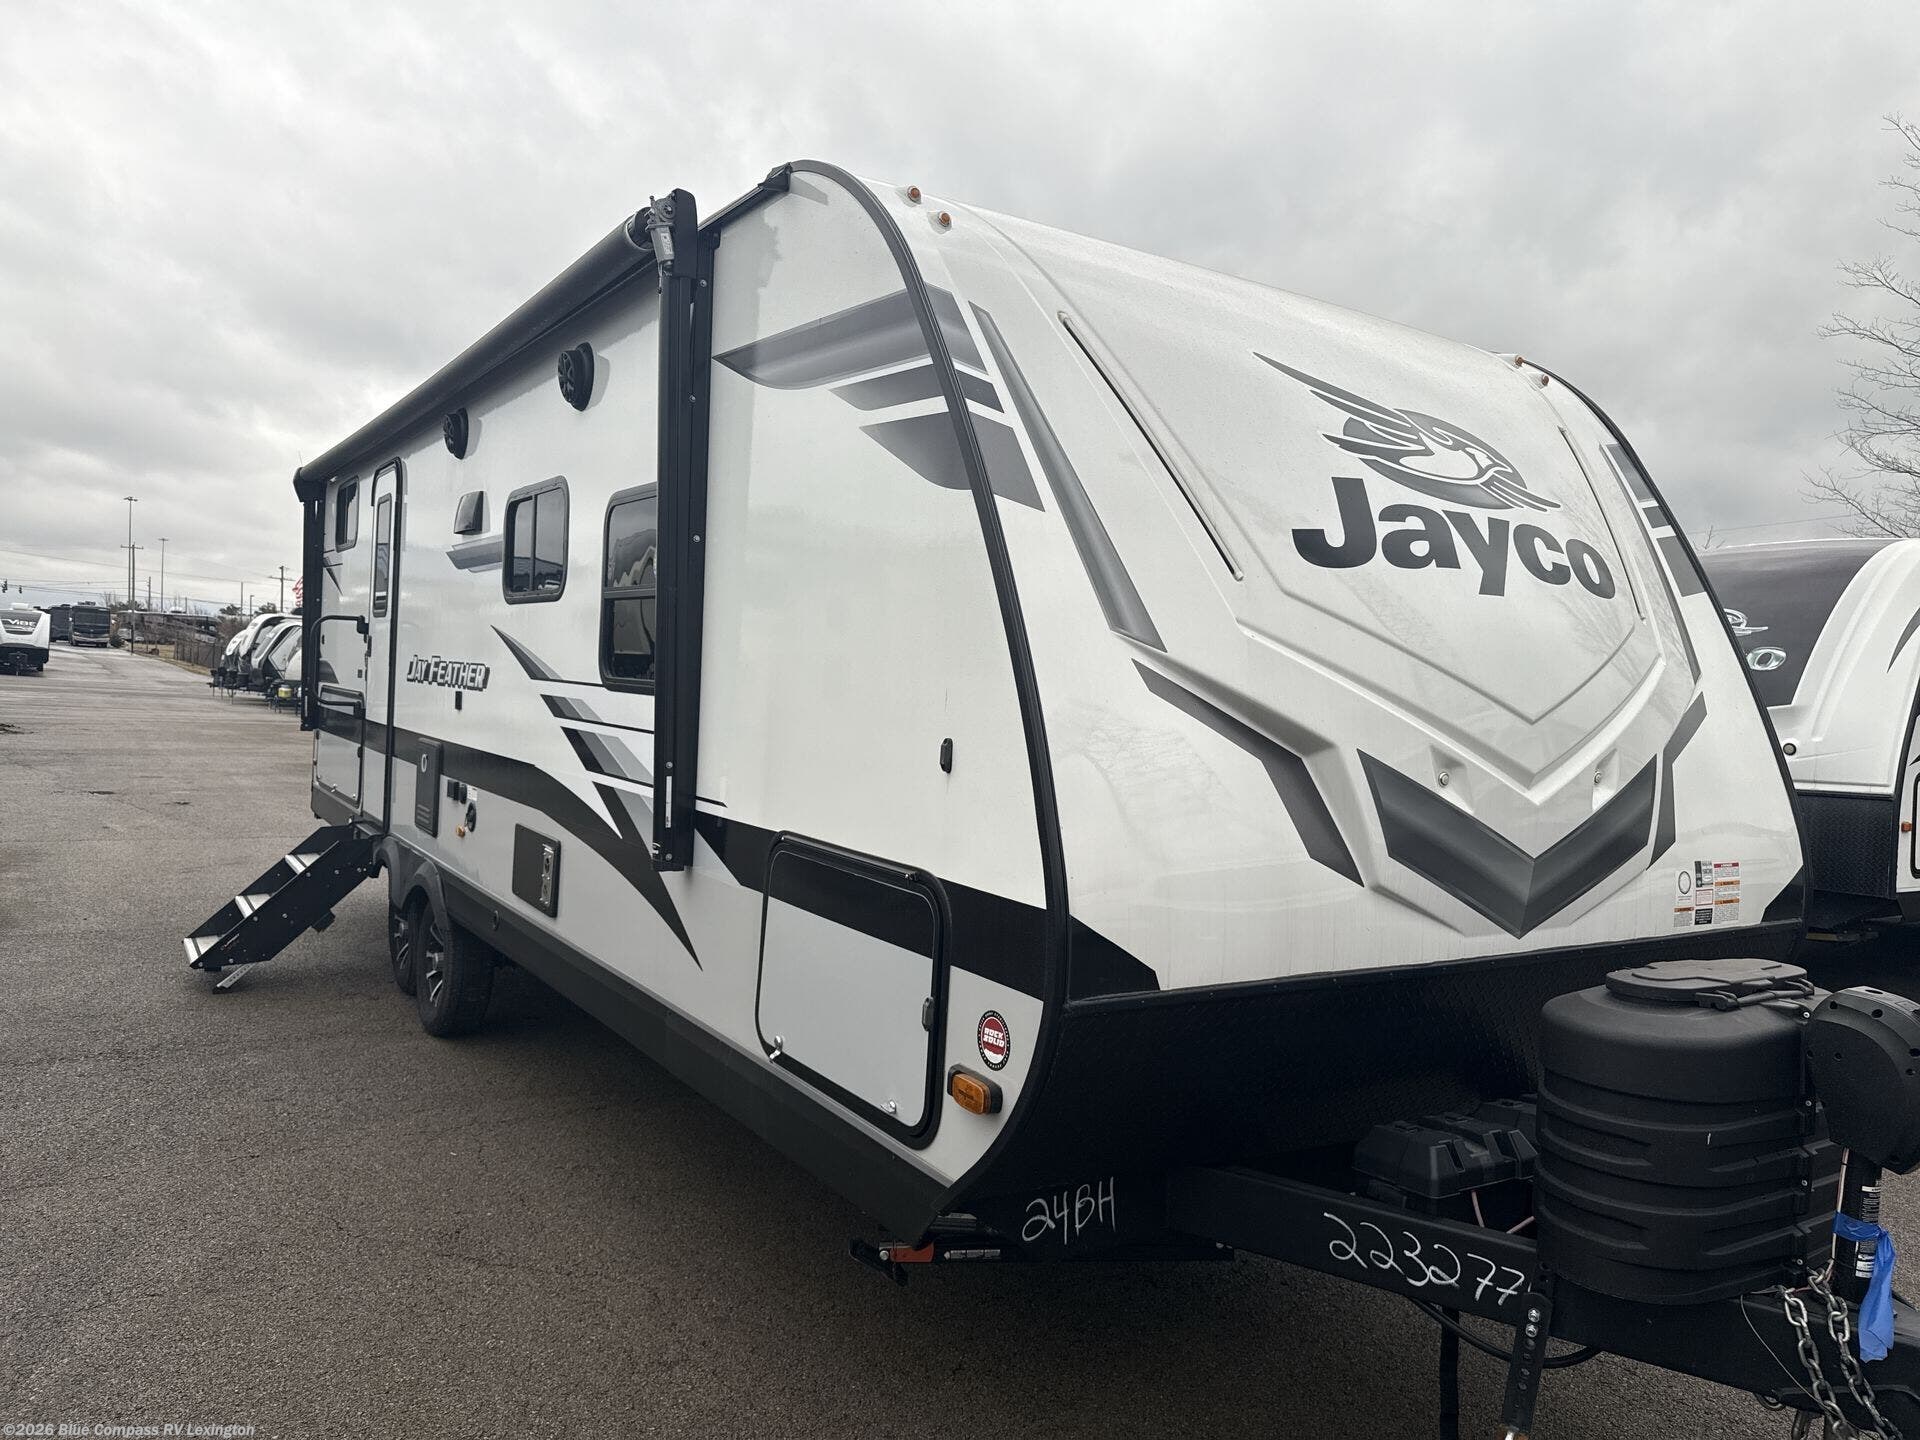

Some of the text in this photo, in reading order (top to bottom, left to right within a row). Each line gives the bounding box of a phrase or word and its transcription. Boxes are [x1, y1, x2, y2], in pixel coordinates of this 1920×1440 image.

[1291, 476, 1617, 600] Jayco
[407, 654, 490, 691] JAY FEATHER
[1021, 1176, 1116, 1246] 24BH
[1323, 1212, 1526, 1306] 223277
